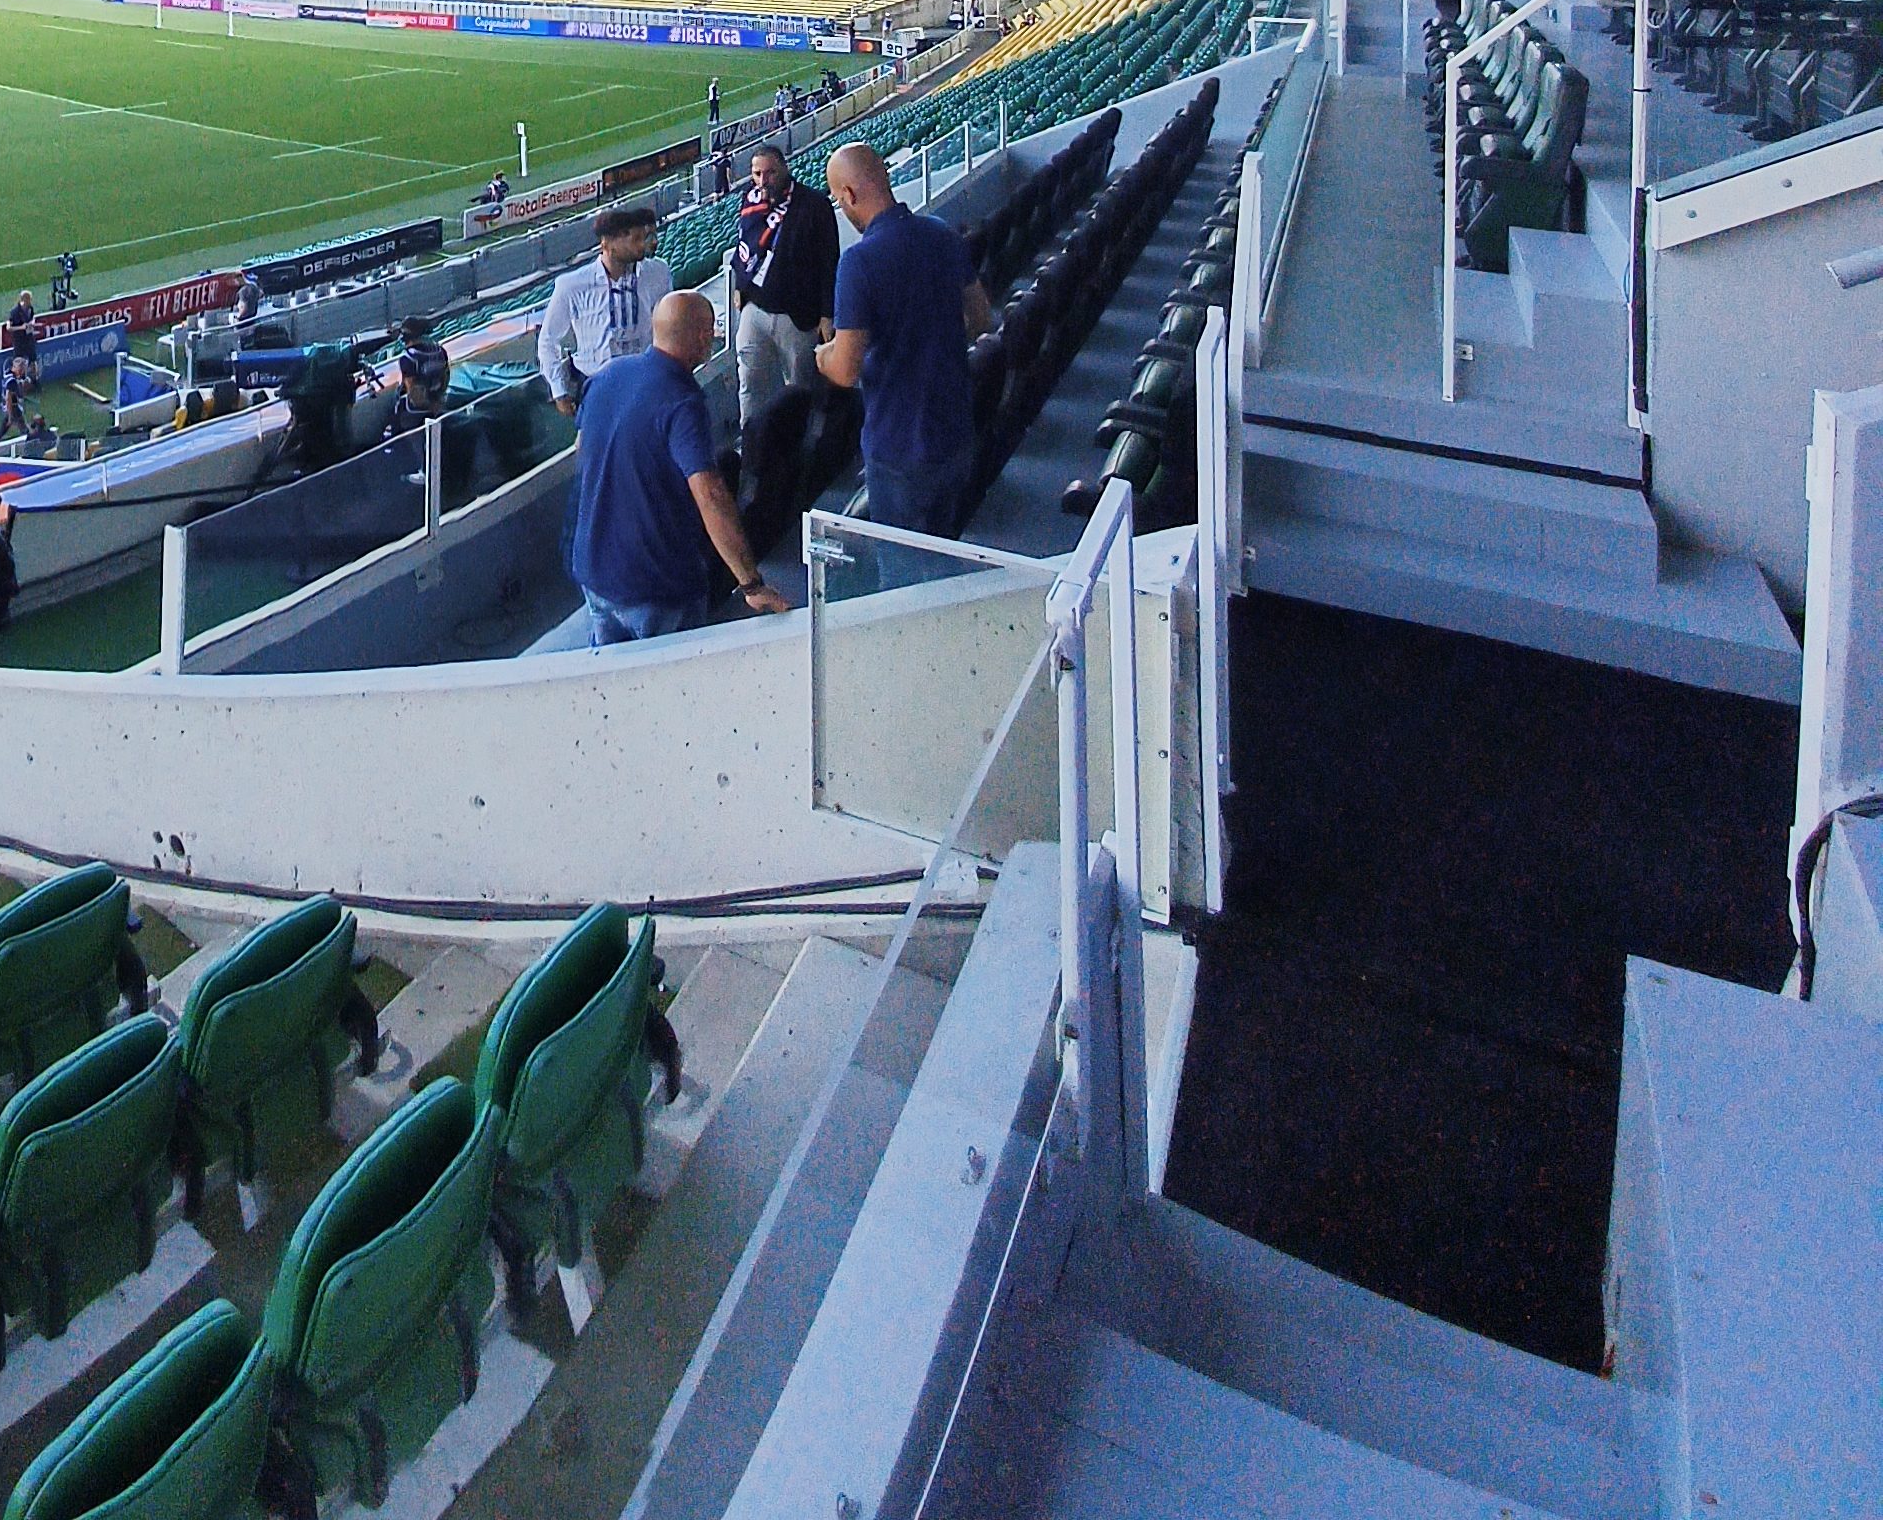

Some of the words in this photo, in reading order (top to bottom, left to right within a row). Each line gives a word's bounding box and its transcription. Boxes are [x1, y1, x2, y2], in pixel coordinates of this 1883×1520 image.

[564, 20, 648, 42] #RWC2023
[143, 291, 171, 321] FLY
[172, 280, 219, 313] BETTER
